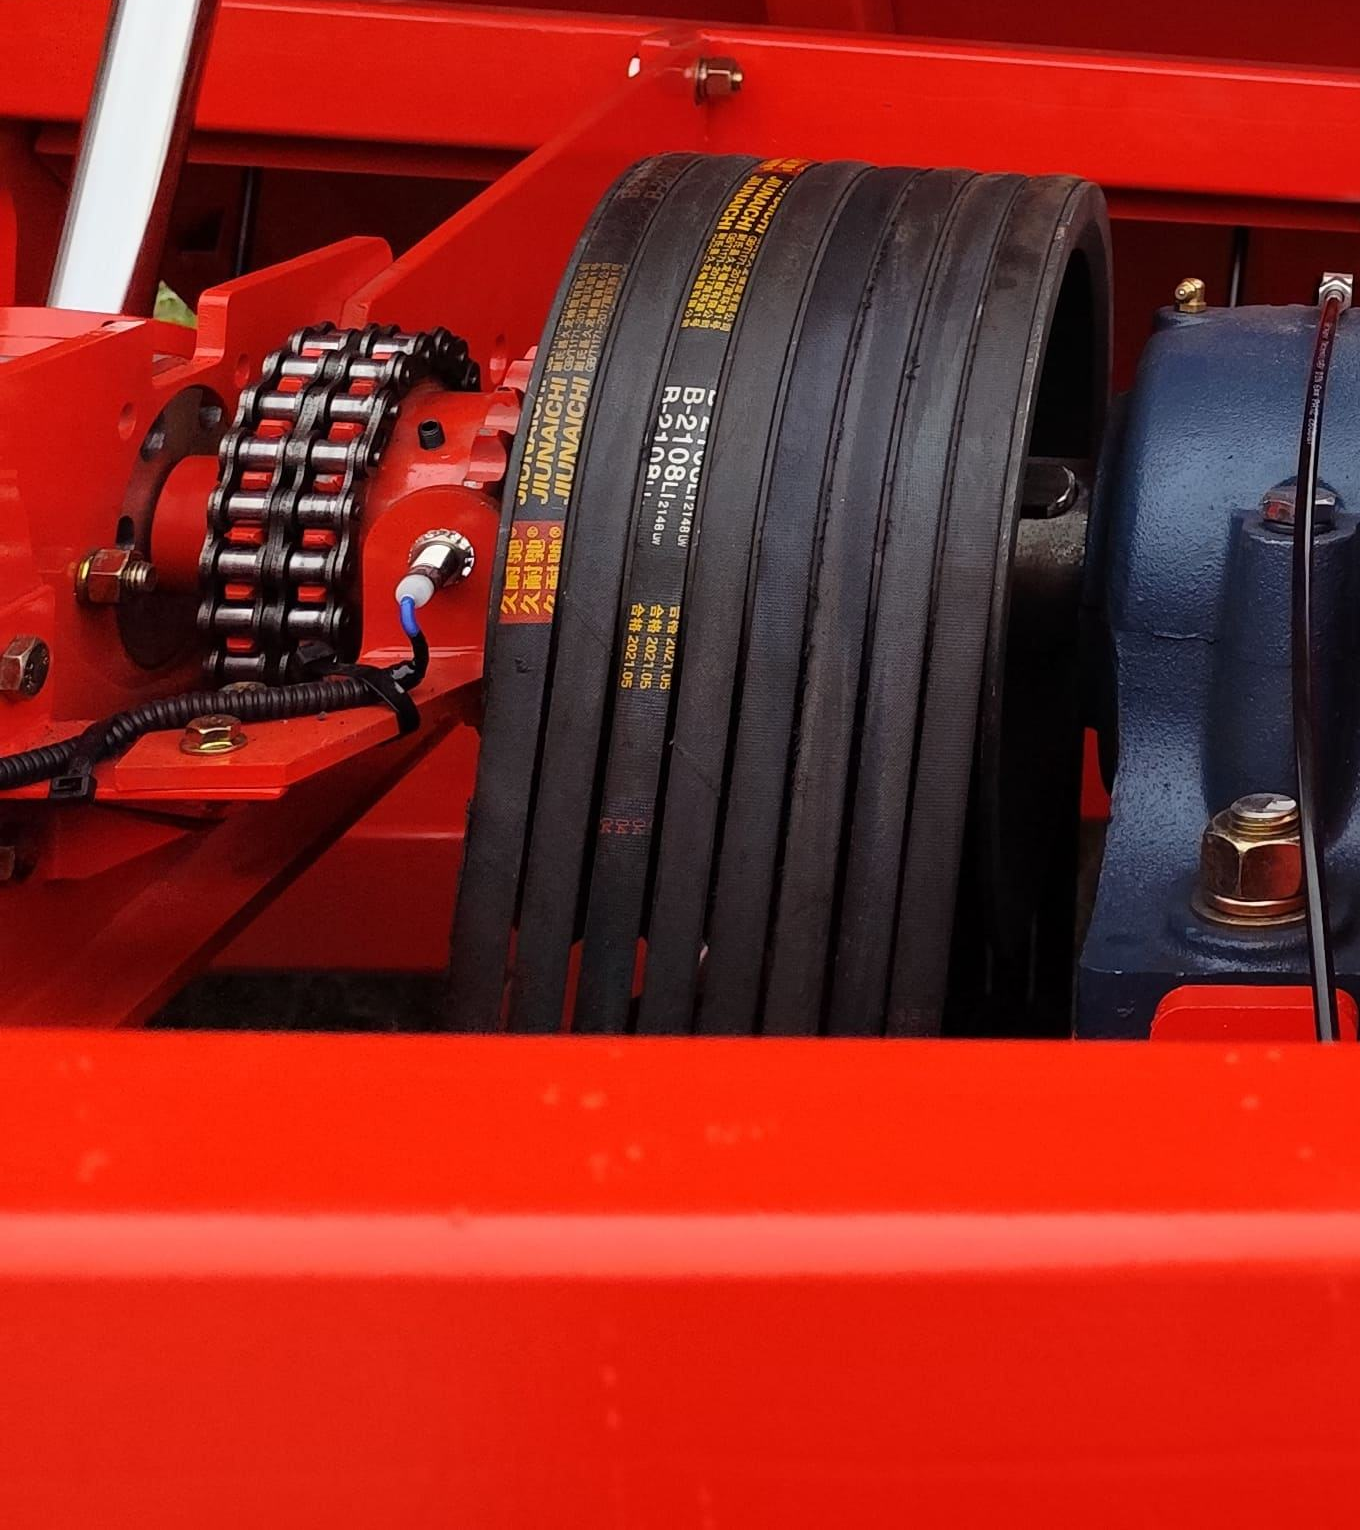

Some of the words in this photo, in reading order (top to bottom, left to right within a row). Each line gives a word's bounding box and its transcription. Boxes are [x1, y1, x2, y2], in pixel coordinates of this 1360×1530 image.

[717, 175, 761, 230] JIUNAICHI
[735, 176, 782, 232] JIUNAICHI
[531, 376, 568, 505] JIUNAICHI
[553, 376, 590, 505] JIUNAICHI
[628, 603, 645, 632] 合格
[646, 604, 665, 633] 合格
[620, 635, 639, 688] 2021.05
[640, 636, 658, 689] 2021.05
